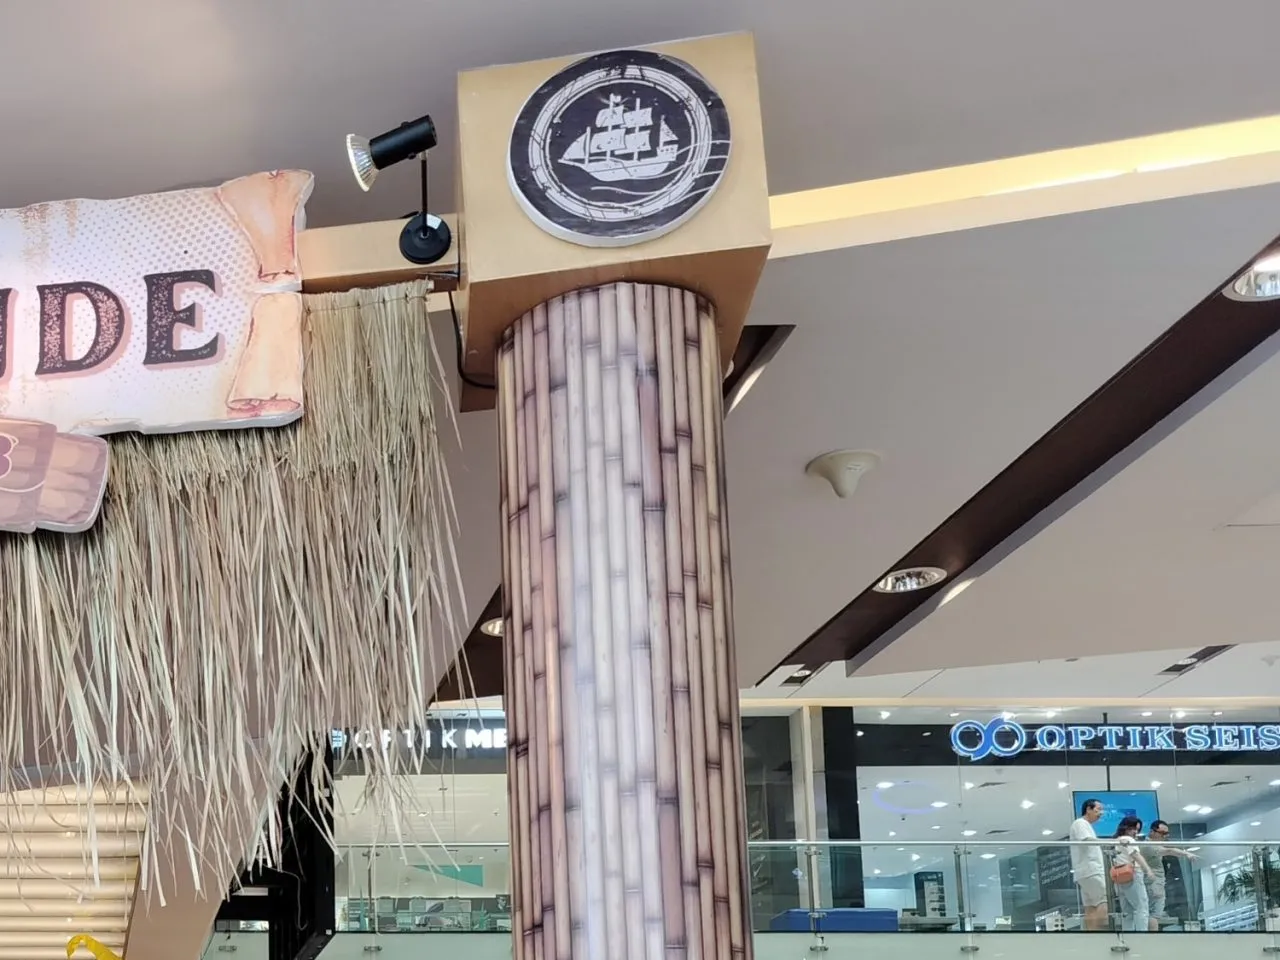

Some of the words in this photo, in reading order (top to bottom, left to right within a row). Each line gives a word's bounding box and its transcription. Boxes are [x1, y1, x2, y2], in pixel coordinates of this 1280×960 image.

[465, 728, 508, 749] ME
[1036, 725, 1176, 750] OPTIK
[1184, 725, 1280, 751] SEIS
